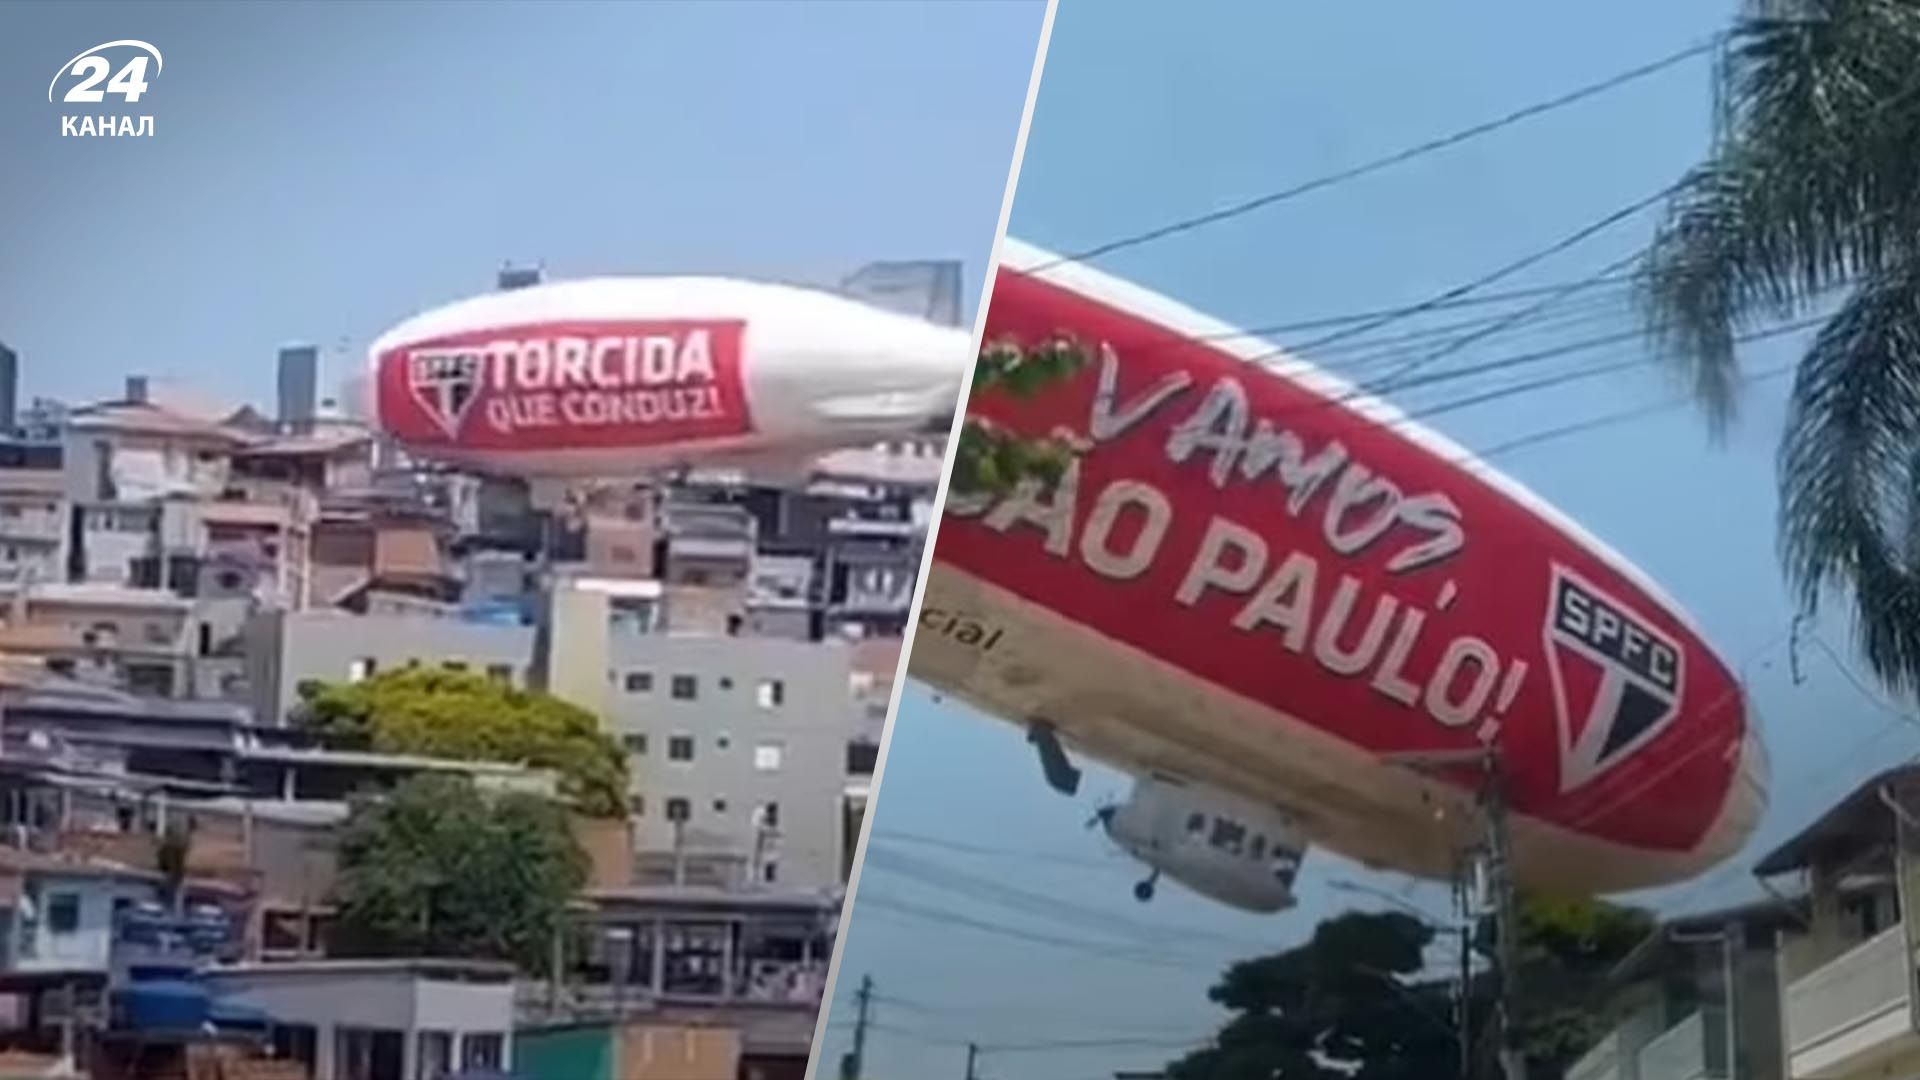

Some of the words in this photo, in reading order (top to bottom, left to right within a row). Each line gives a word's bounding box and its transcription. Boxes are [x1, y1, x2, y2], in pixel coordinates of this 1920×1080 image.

[487, 328, 715, 388] TORCIDA
[487, 394, 561, 434] QUE
[1173, 515, 1529, 741] PAULO!
[1561, 588, 1675, 685] SPFC
